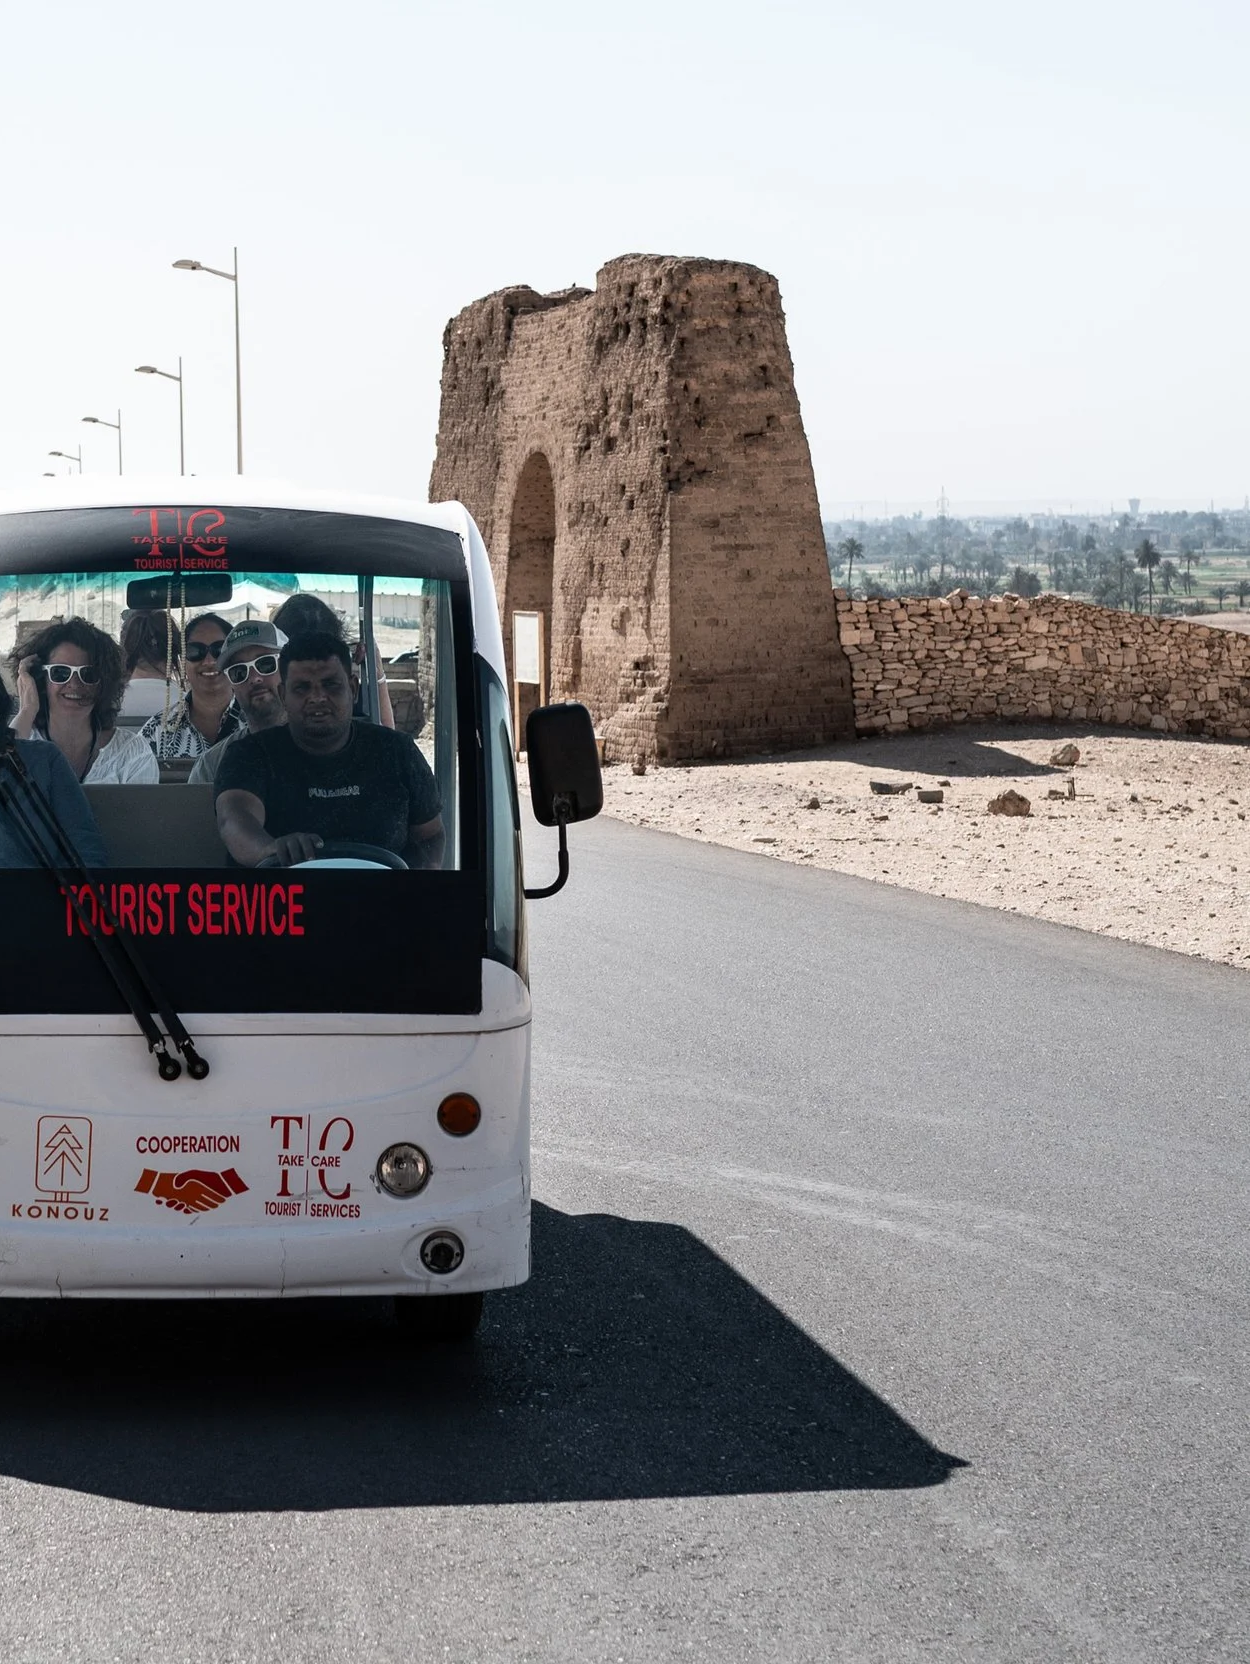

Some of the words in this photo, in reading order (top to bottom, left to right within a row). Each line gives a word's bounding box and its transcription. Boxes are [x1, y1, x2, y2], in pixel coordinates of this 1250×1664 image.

[131, 536, 177, 544] TAKE
[183, 536, 228, 544] CARE
[134, 558, 177, 569] TOURIST
[184, 558, 229, 569] SERVICE
[60, 883, 181, 937] TOURIST
[187, 883, 305, 936] SERVICE
[136, 1135, 240, 1154] COOPERATION
[278, 1154, 305, 1167] TAKE
[311, 1155, 341, 1168] CARE
[12, 1204, 109, 1221] KONOUZ
[265, 1201, 301, 1216] TOURIST
[310, 1203, 361, 1218] SERVICES
